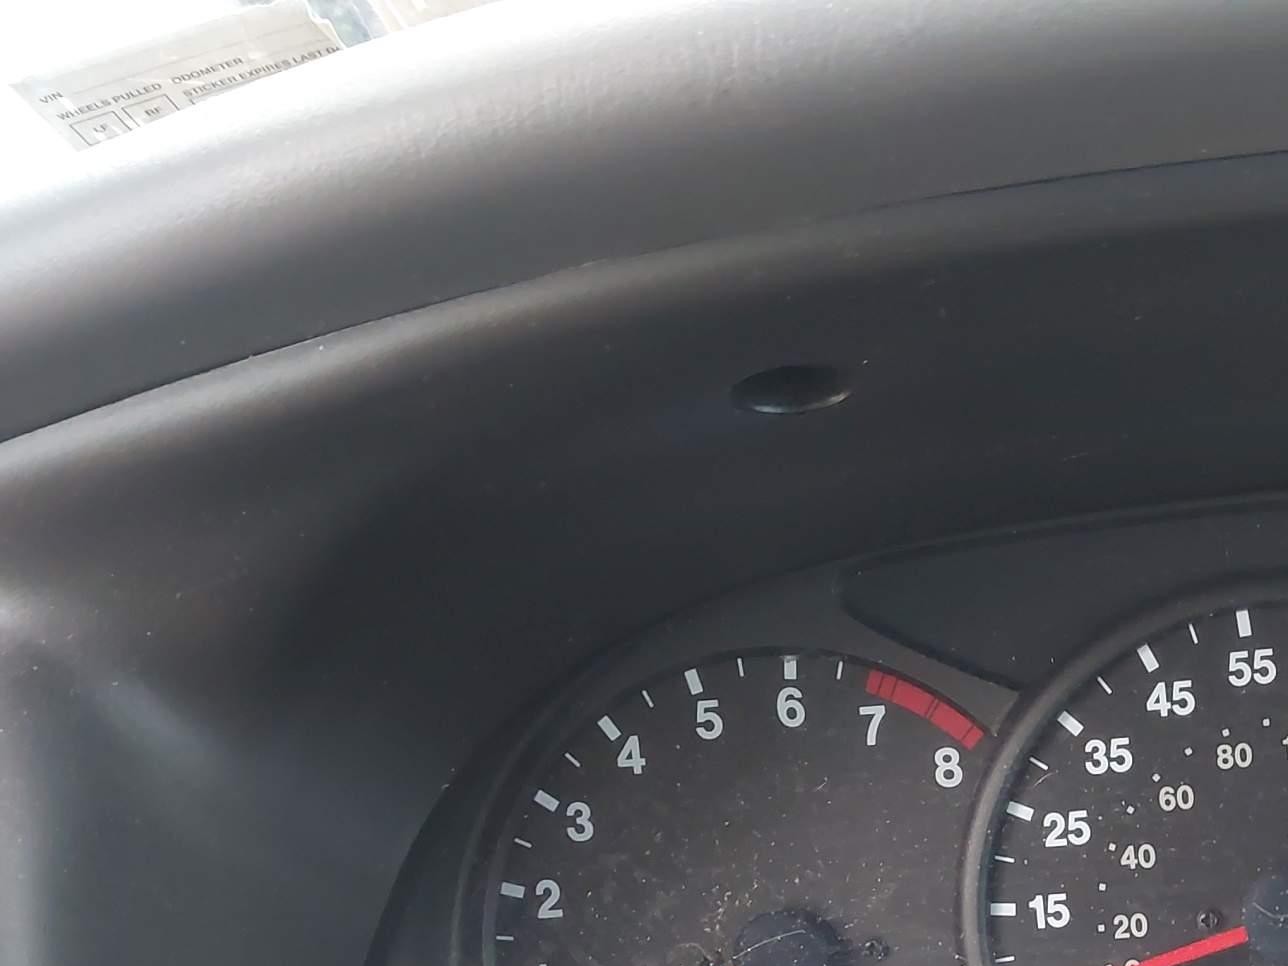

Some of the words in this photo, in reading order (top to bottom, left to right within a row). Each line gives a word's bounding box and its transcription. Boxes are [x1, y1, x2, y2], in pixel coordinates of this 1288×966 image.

[172, 57, 243, 85] ODOMETER
[292, 50, 326, 66] LAST
[39, 91, 64, 104] VIN
[56, 99, 111, 120] WHEELS
[112, 83, 162, 104] PULLED
[1229, 649, 1276, 686] 55
[777, 687, 805, 727] 6
[1147, 680, 1195, 716] 45
[696, 700, 723, 739] 5
[860, 705, 885, 745] 7
[617, 735, 646, 774] 4
[935, 748, 962, 787] 8
[1085, 738, 1132, 774] 35
[1217, 743, 1252, 769] 80
[1159, 785, 1194, 811] 60
[567, 802, 593, 841] 3
[1044, 810, 1090, 847] 25
[1121, 844, 1155, 869] 40
[536, 880, 563, 918] 2
[1029, 894, 1070, 929] 15
[1114, 913, 1147, 939] 20
